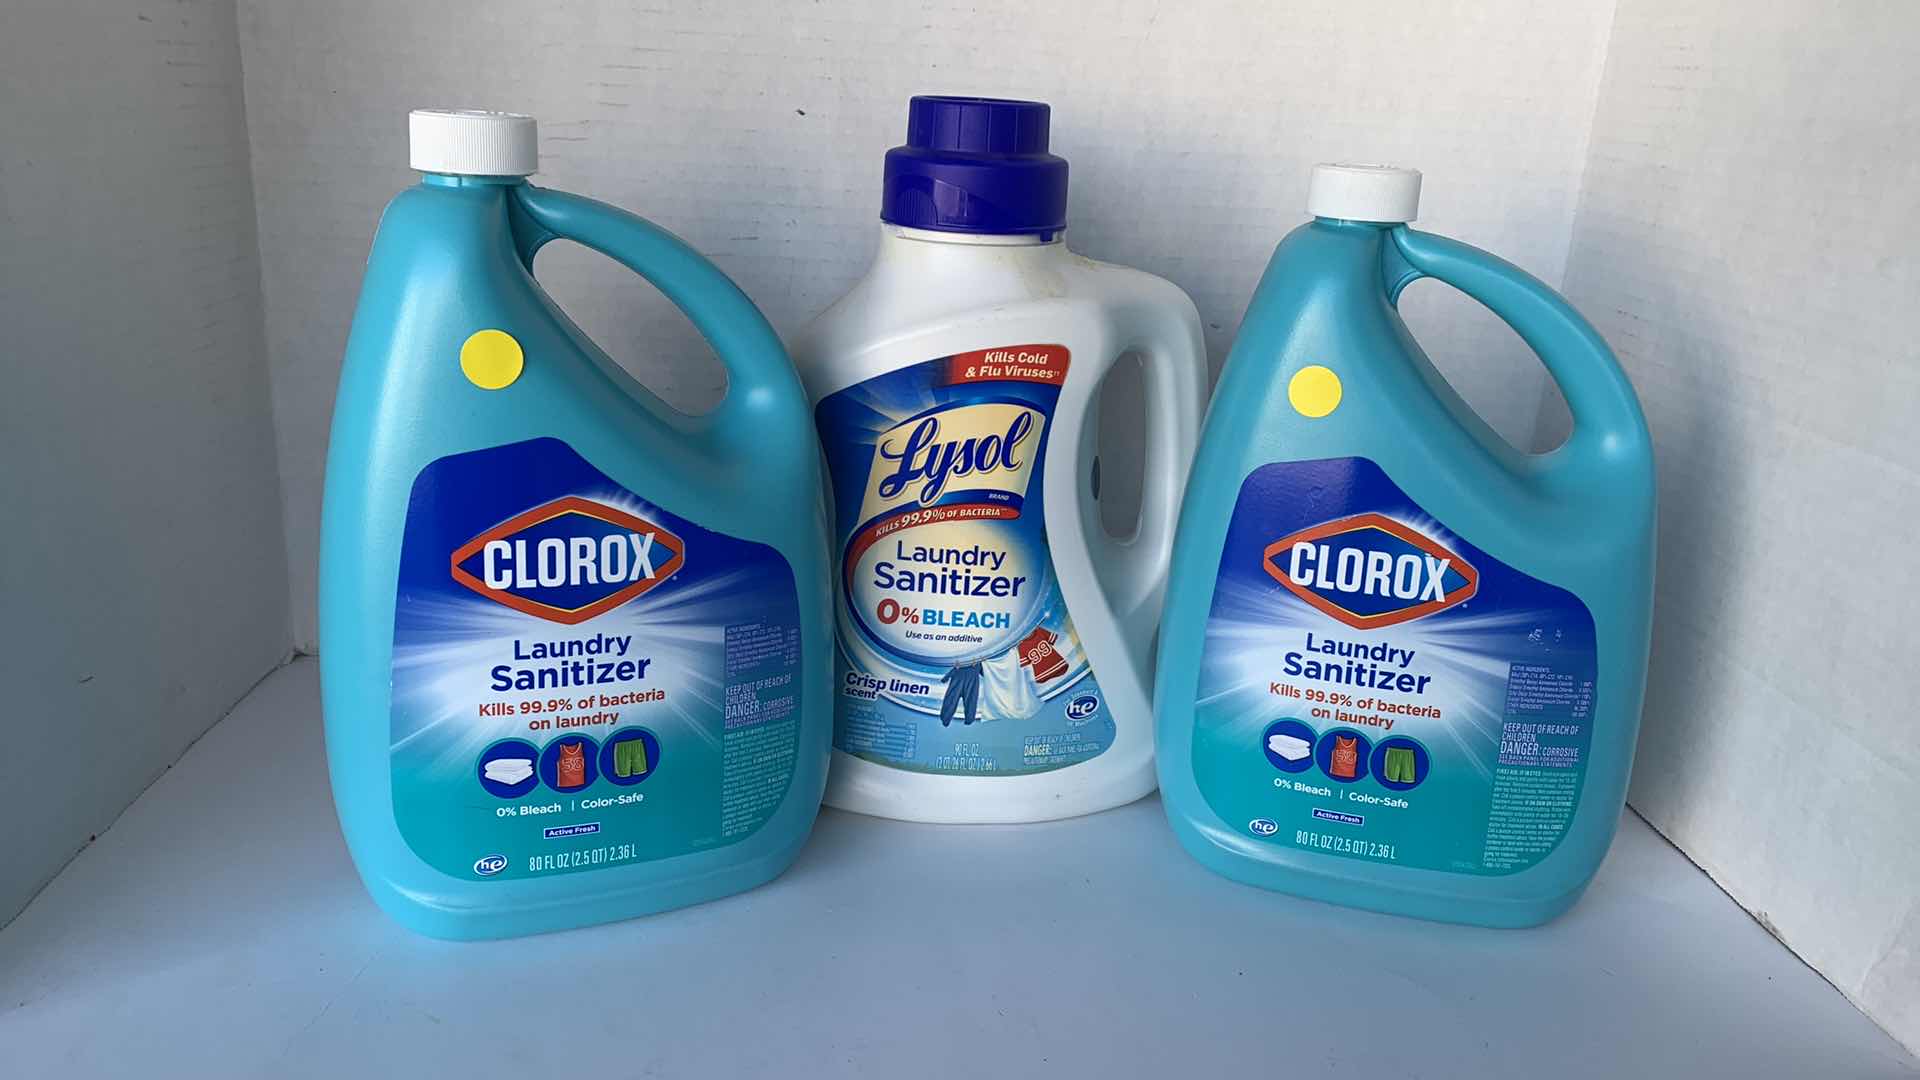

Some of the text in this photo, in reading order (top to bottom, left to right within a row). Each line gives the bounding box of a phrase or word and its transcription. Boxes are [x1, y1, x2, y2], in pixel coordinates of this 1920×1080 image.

[965, 367, 976, 378] &
[980, 365, 1001, 377] Flu
[984, 352, 1048, 365] Kills Cold
[879, 411, 1033, 506] Lysol
[989, 493, 1009, 501] BRAND
[875, 522, 900, 537] KILLS
[902, 507, 945, 527] 99.9%
[483, 532, 656, 590] CLOROX
[896, 540, 1007, 571] Laundry
[873, 562, 1026, 597] Sanitizer
[1289, 542, 1450, 603] CLOROX
[877, 598, 1010, 629] 0% BLEACH
[514, 632, 632, 660] Laundry
[905, 630, 921, 640] Use
[948, 633, 983, 643] additive
[1028, 641, 1052, 664] 99
[1306, 633, 1415, 668] Laundry
[490, 658, 651, 691] Sanitizer
[846, 672, 930, 695] Crisp linen
[1283, 652, 1432, 695] Sanitizer
[479, 688, 666, 716] Kills 99.9% of bacteria
[845, 687, 877, 699] scent
[1270, 682, 1441, 718] Kills 99.9% of bacteria
[528, 711, 620, 731] on laundry
[1311, 707, 1394, 730] on laundry
[1503, 722, 1579, 735] KEEP OUT OF REACH OF
[1542, 747, 1579, 757] CORROSIVE
[496, 792, 644, 817] 0% Bleach Color-Safe
[1274, 778, 1409, 809] 0% Bleach Color-Safe
[548, 824, 596, 837] Active Fresh
[1317, 811, 1360, 824] Active Fresh
[529, 844, 637, 871] 80 FL OZ (2.5 QT) 2.36 L
[1296, 830, 1397, 860] 80 FL OZ (2.5 QT) 2.36 L
